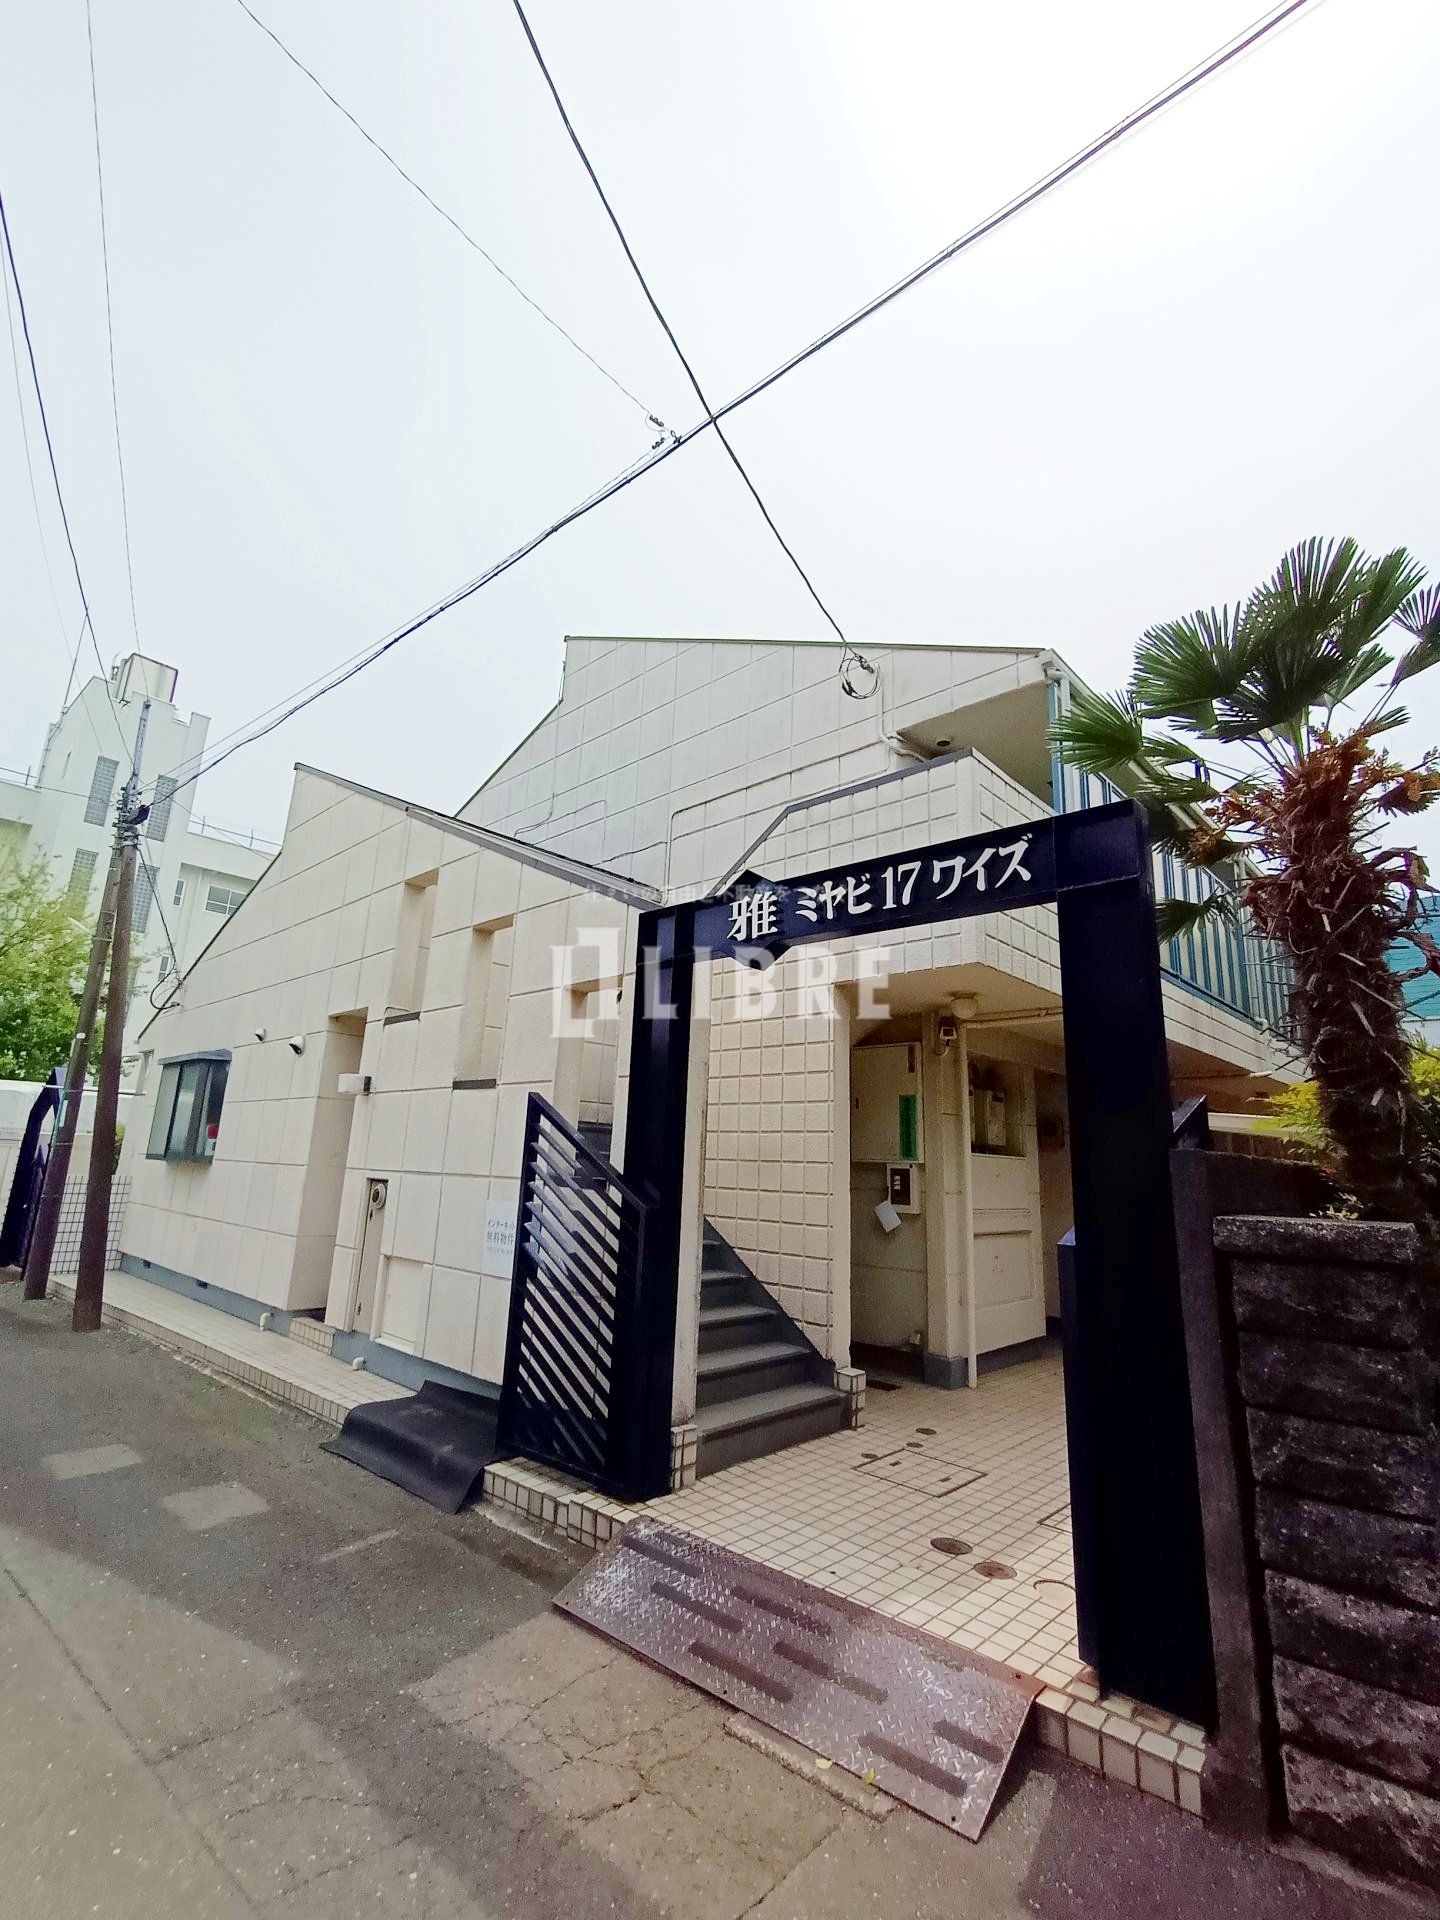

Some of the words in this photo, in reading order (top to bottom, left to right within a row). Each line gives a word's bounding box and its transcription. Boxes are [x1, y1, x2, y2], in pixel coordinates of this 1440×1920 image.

[727, 891, 778, 942] 雅
[795, 873, 873, 922] ミヤビ
[881, 860, 922, 910] 17
[932, 833, 1033, 900] ワイズ
